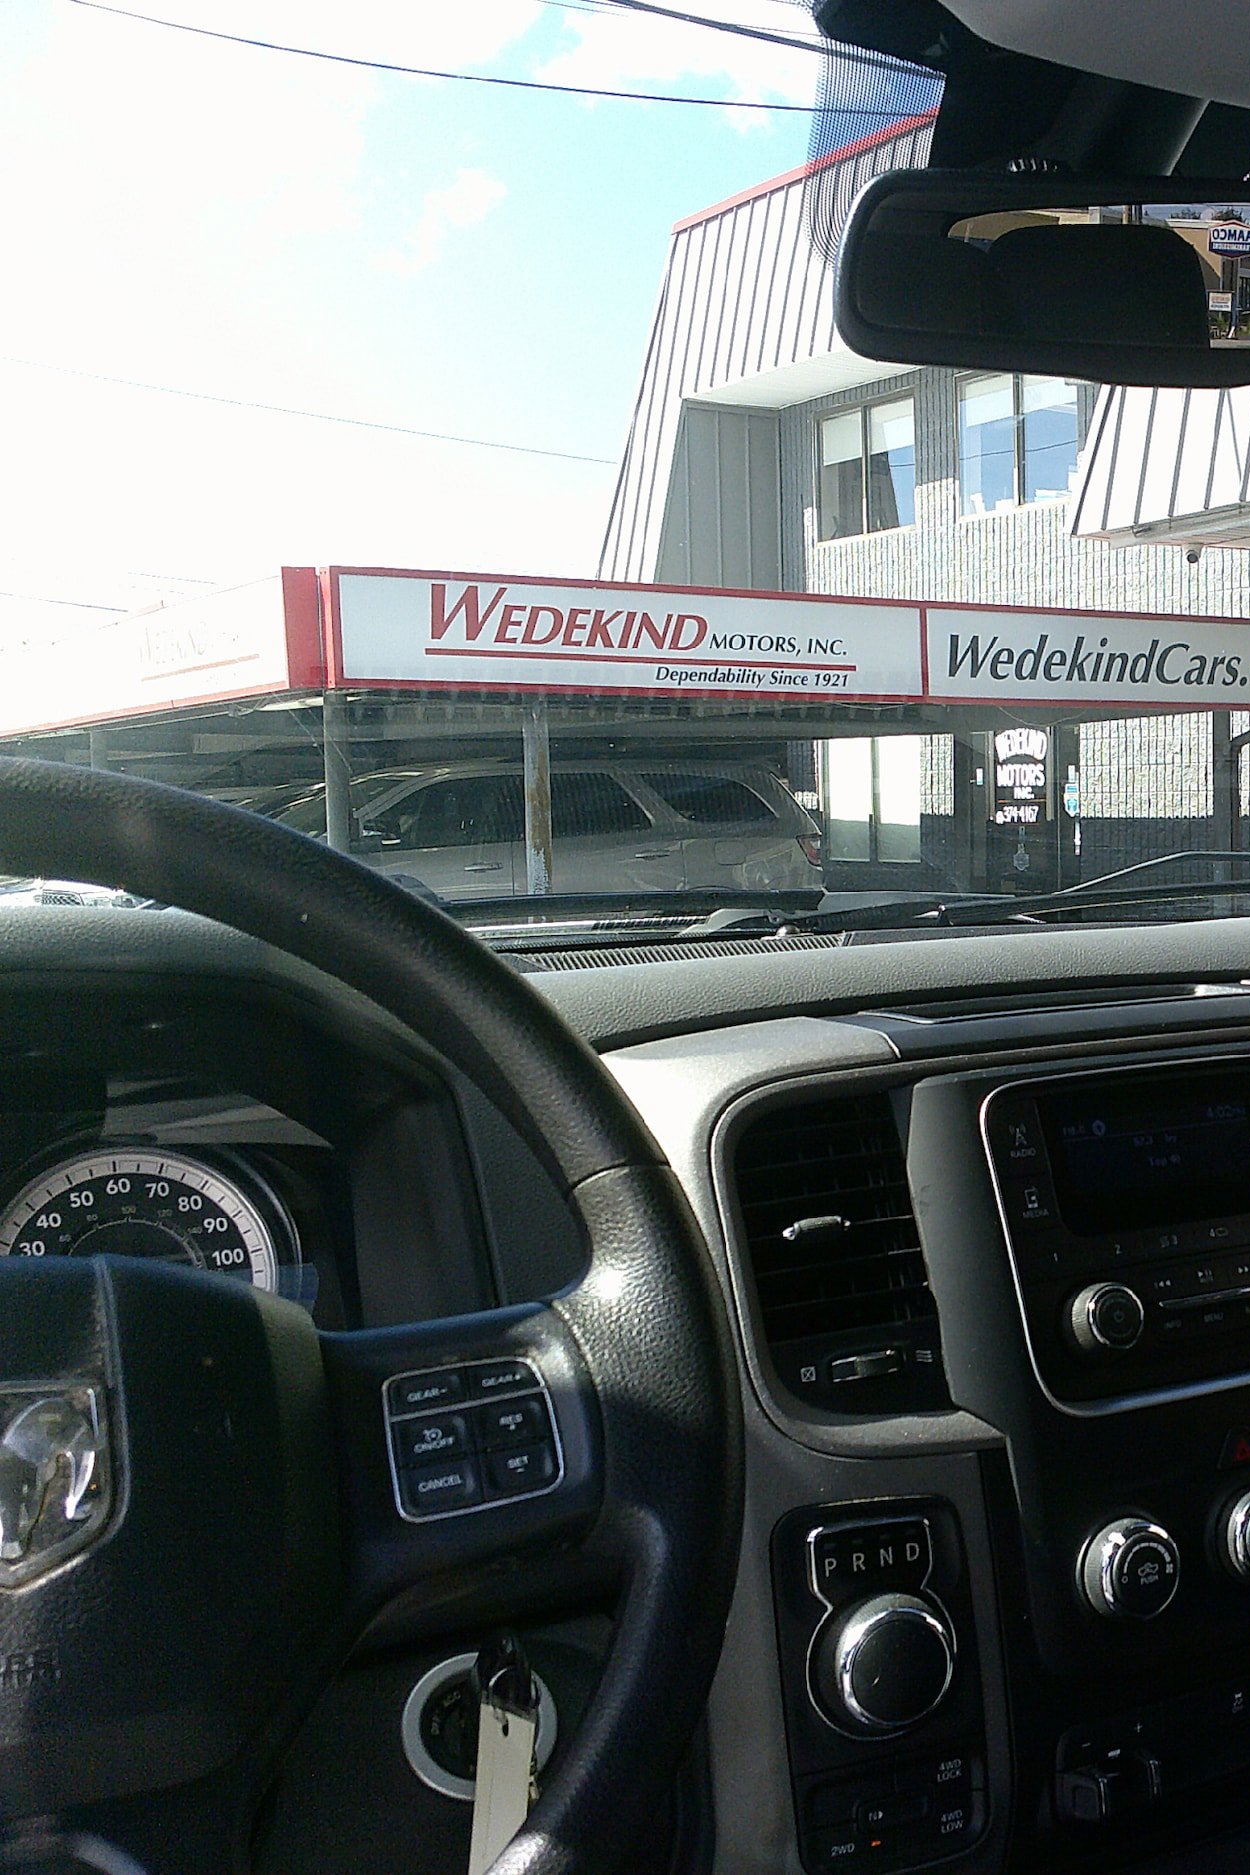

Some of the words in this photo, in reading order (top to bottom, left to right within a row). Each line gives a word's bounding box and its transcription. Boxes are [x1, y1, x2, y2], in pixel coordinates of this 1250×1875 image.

[430, 582, 709, 652] WEDEKIND
[709, 633, 801, 657] MOTORS,
[807, 636, 848, 657] INC.
[655, 666, 767, 688] Dependability
[769, 670, 811, 687] Since
[813, 672, 849, 688] 1921
[997, 763, 1046, 787] MOTORS
[106, 1178, 131, 1194] 60
[145, 1182, 170, 1198] 70
[70, 1190, 94, 1208] 50
[178, 1195, 202, 1212] 80
[36, 1213, 62, 1229] 40
[203, 1217, 228, 1235] 90
[19, 1240, 46, 1257] 30
[212, 1248, 244, 1266] 100
[1114, 1243, 1123, 1255] 2
[418, 1474, 462, 1493] CANCEL
[824, 1558, 837, 1578] P
[853, 1552, 866, 1572] R
[880, 1546, 893, 1567] N
[906, 1542, 920, 1561] D
[939, 1759, 962, 1772] 4WD
[937, 1770, 962, 1783] LOCK
[941, 1809, 963, 1823] 4WD
[941, 1820, 964, 1834] LOW
[831, 1843, 855, 1857] 2WD
